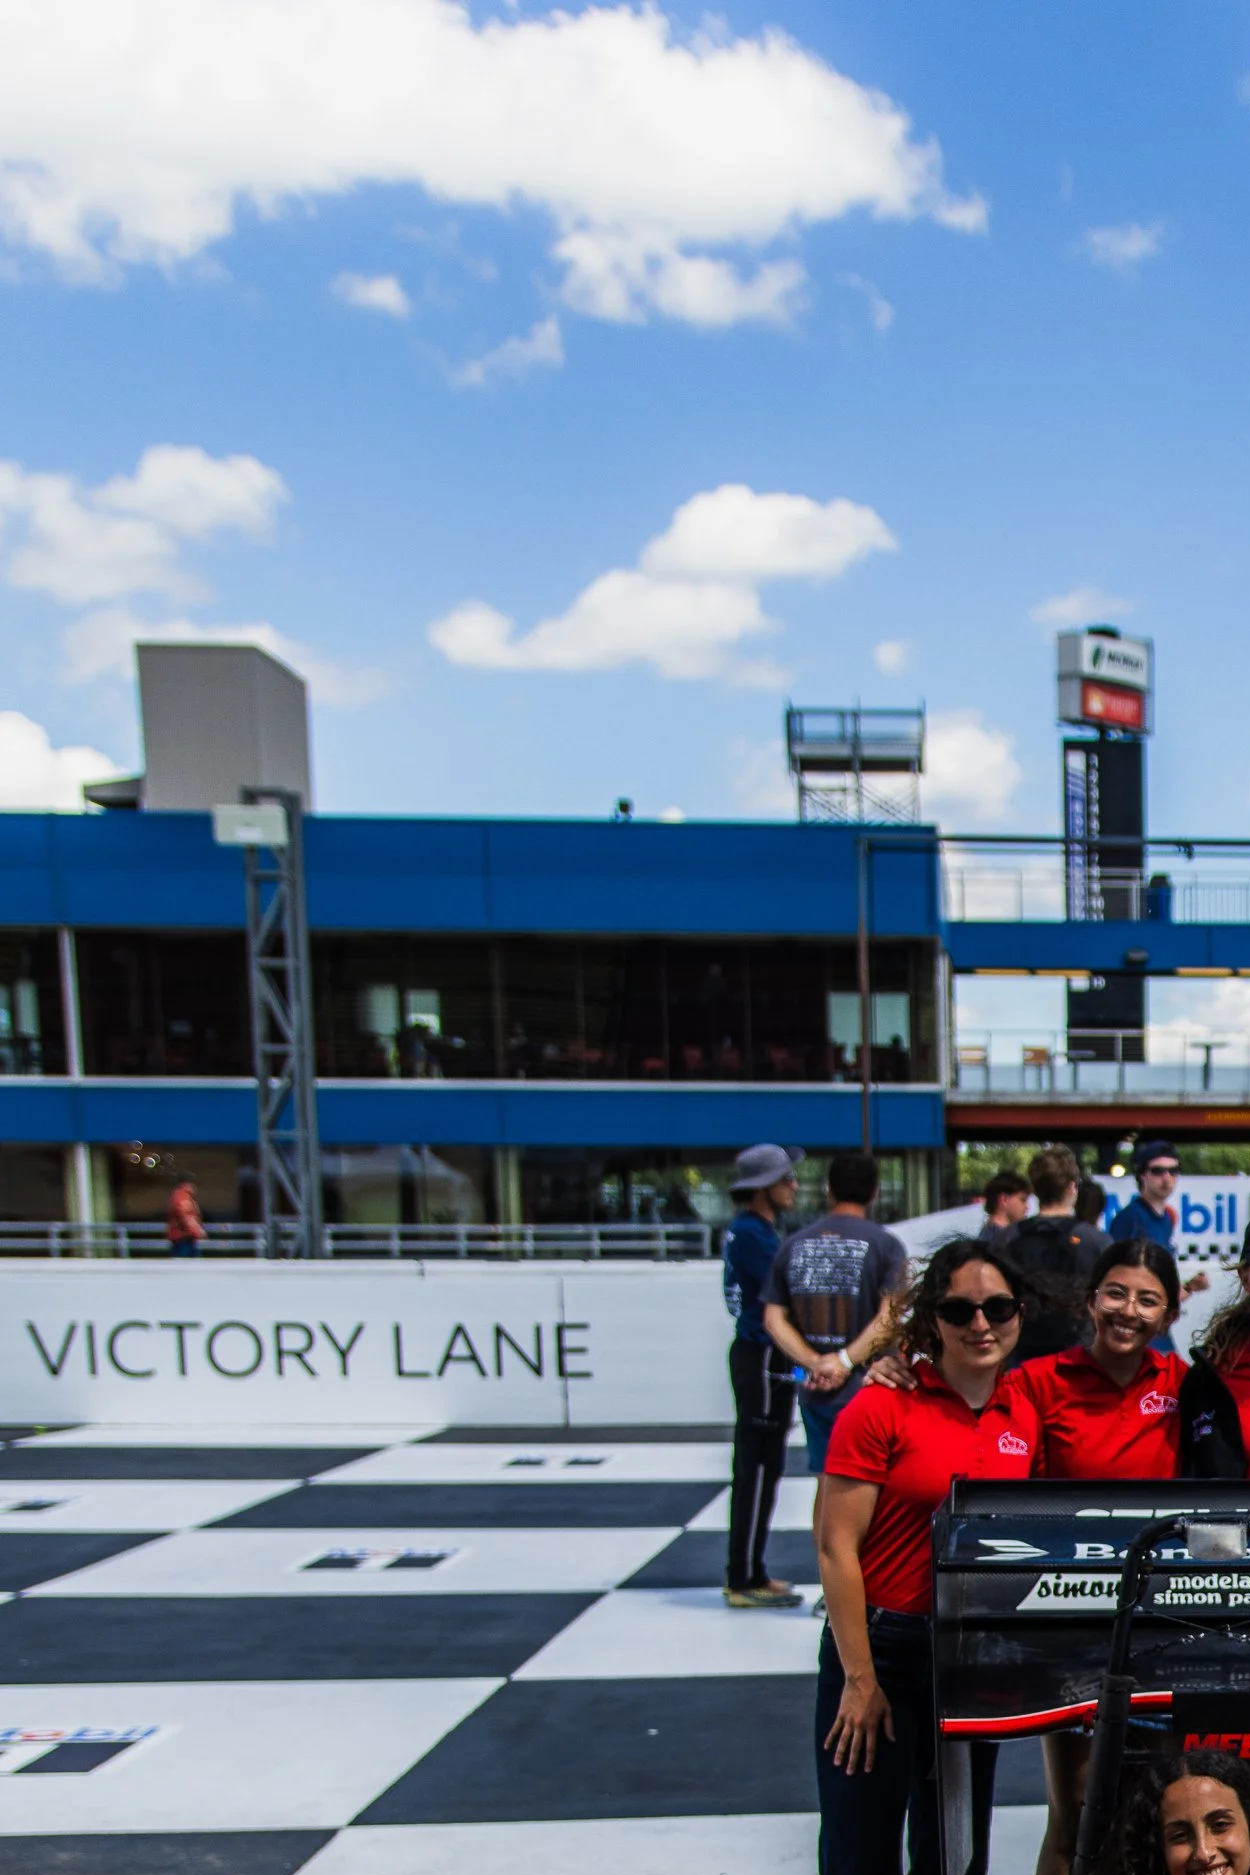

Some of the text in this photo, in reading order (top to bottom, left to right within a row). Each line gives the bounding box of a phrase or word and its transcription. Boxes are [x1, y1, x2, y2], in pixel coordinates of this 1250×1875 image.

[26, 1320, 594, 1378] VICTORY LANE
[1153, 1591, 1222, 1605] simon
